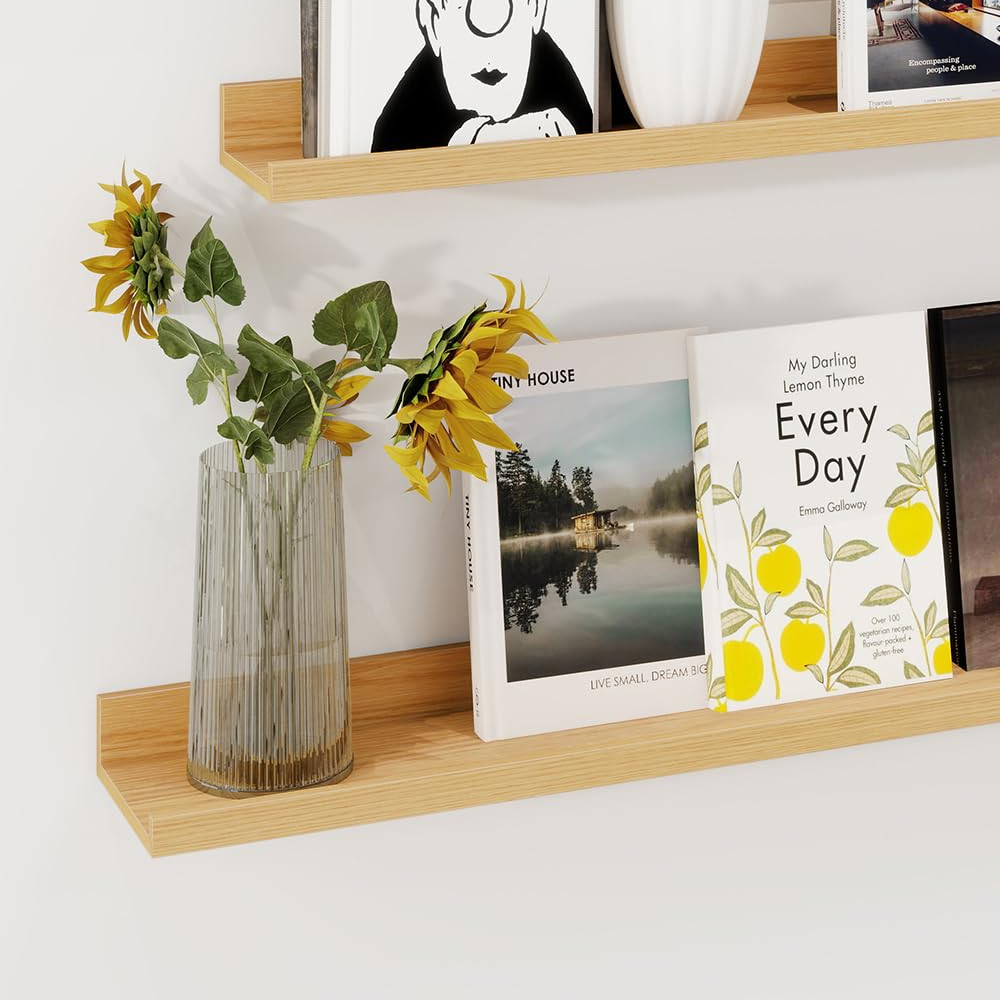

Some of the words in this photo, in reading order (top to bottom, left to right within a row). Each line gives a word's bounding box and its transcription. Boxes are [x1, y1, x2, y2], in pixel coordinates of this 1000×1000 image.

[908, 56, 960, 66] Encompassing
[926, 65, 949, 75] people
[957, 63, 976, 72] place
[788, 359, 807, 375] My
[811, 352, 857, 370] Darling
[528, 369, 575, 386] HOUSE
[783, 380, 821, 394] Lemon
[825, 373, 865, 391] Thyme
[776, 401, 877, 443] Every
[795, 448, 866, 493] Day
[799, 505, 825, 517] Emma
[827, 499, 867, 514] Galloway
[871, 616, 886, 625] Over
[889, 613, 900, 622] 100
[859, 627, 890, 640] vegetarian
[590, 677, 611, 690] LIVE
[613, 672, 649, 687] SMALL,
[651, 666, 688, 682] DREAM
[691, 664, 707, 675] BIG
